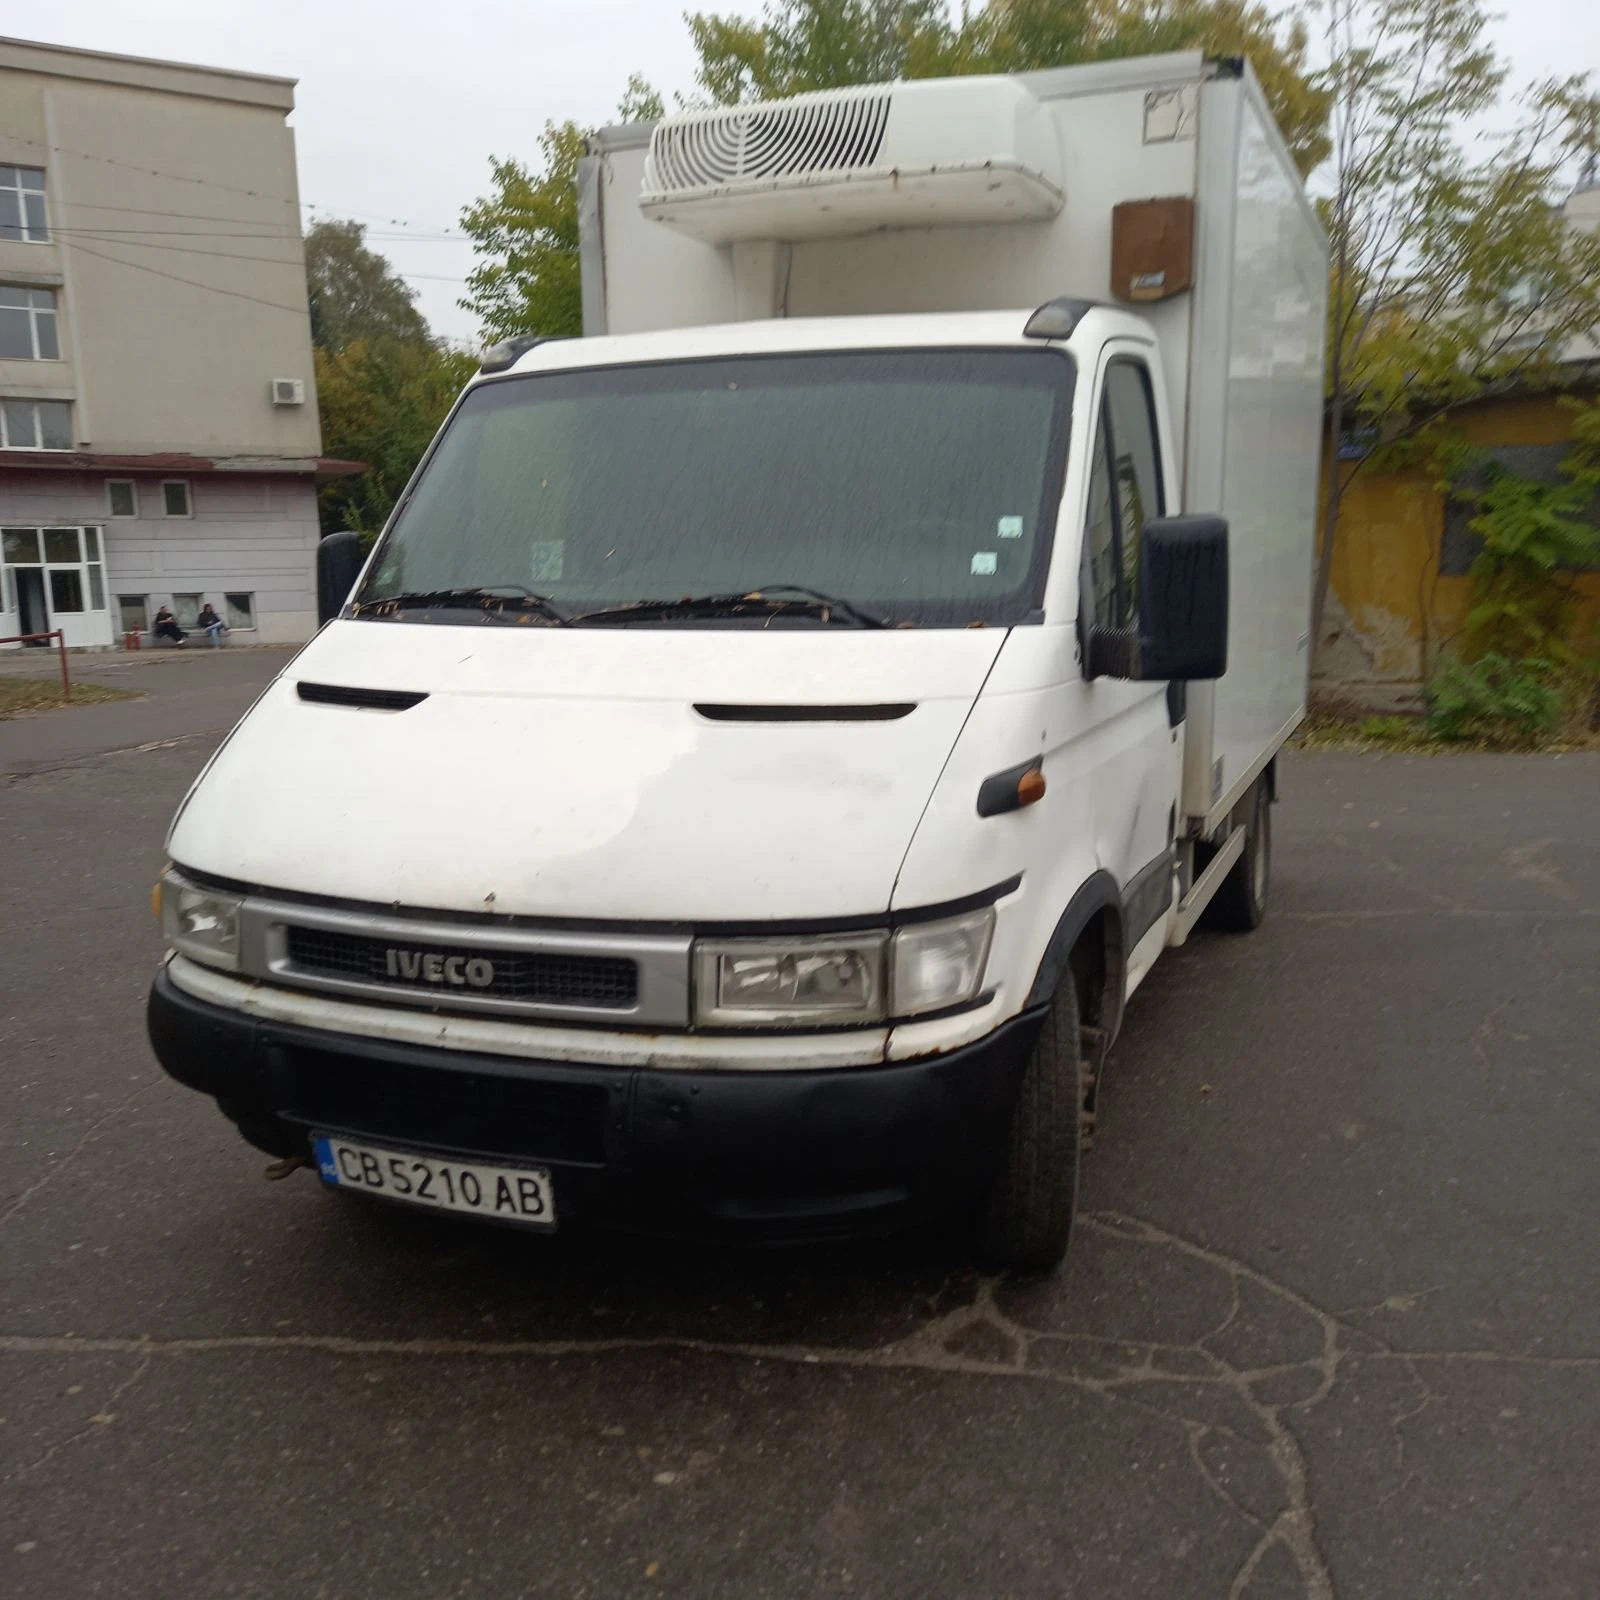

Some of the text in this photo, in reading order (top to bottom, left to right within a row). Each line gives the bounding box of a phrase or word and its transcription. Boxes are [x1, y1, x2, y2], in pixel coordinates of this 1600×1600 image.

[386, 949, 494, 987] IVECO
[337, 1148, 545, 1215] CB 5210 AB
